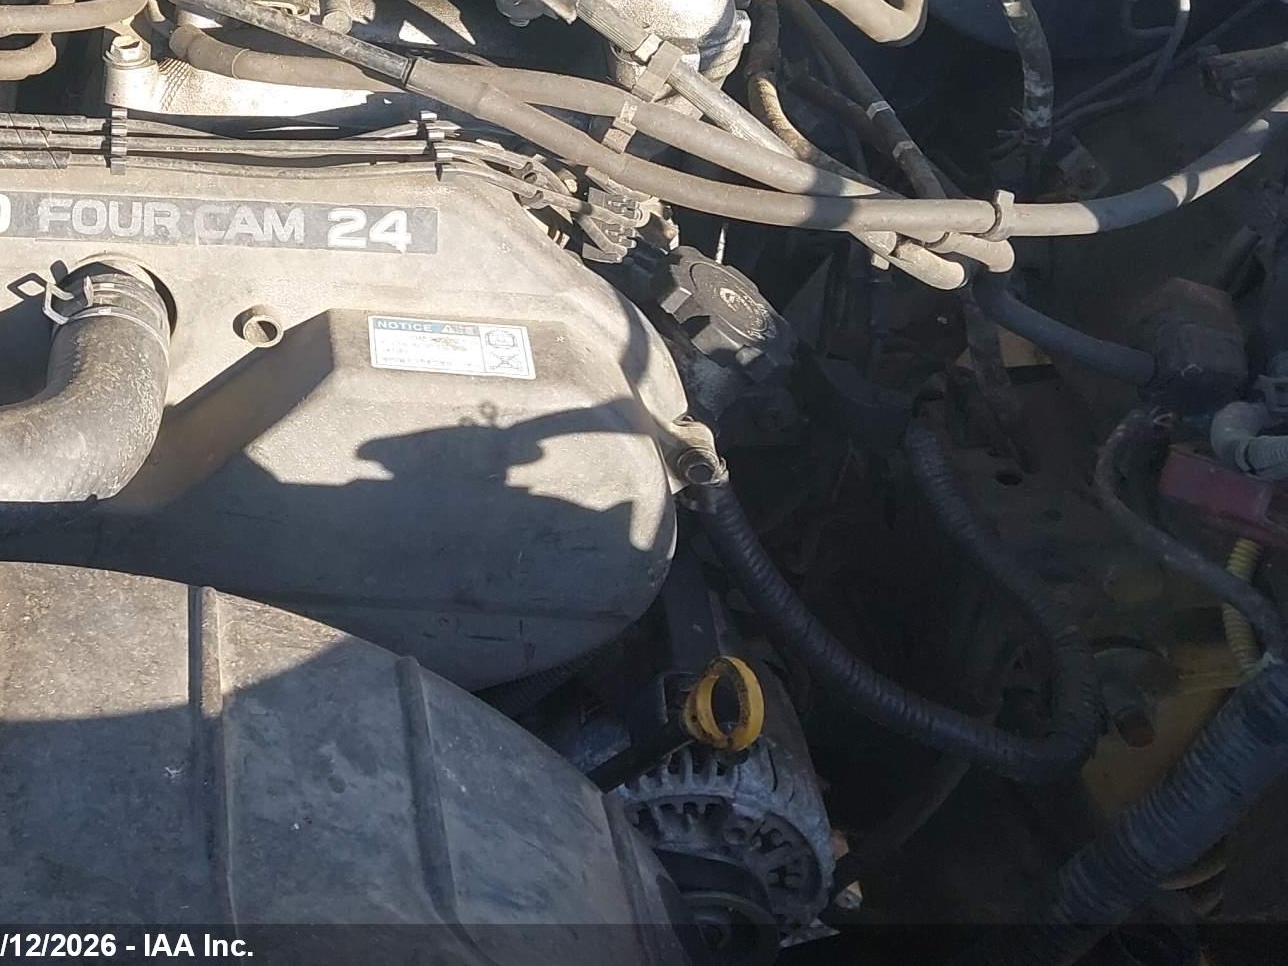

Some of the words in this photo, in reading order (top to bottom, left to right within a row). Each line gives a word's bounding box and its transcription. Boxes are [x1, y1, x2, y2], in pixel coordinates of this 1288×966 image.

[37, 198, 184, 240] FOUR
[192, 205, 304, 243] CAM
[326, 208, 413, 251] 24
[376, 320, 433, 332] NOTICE
